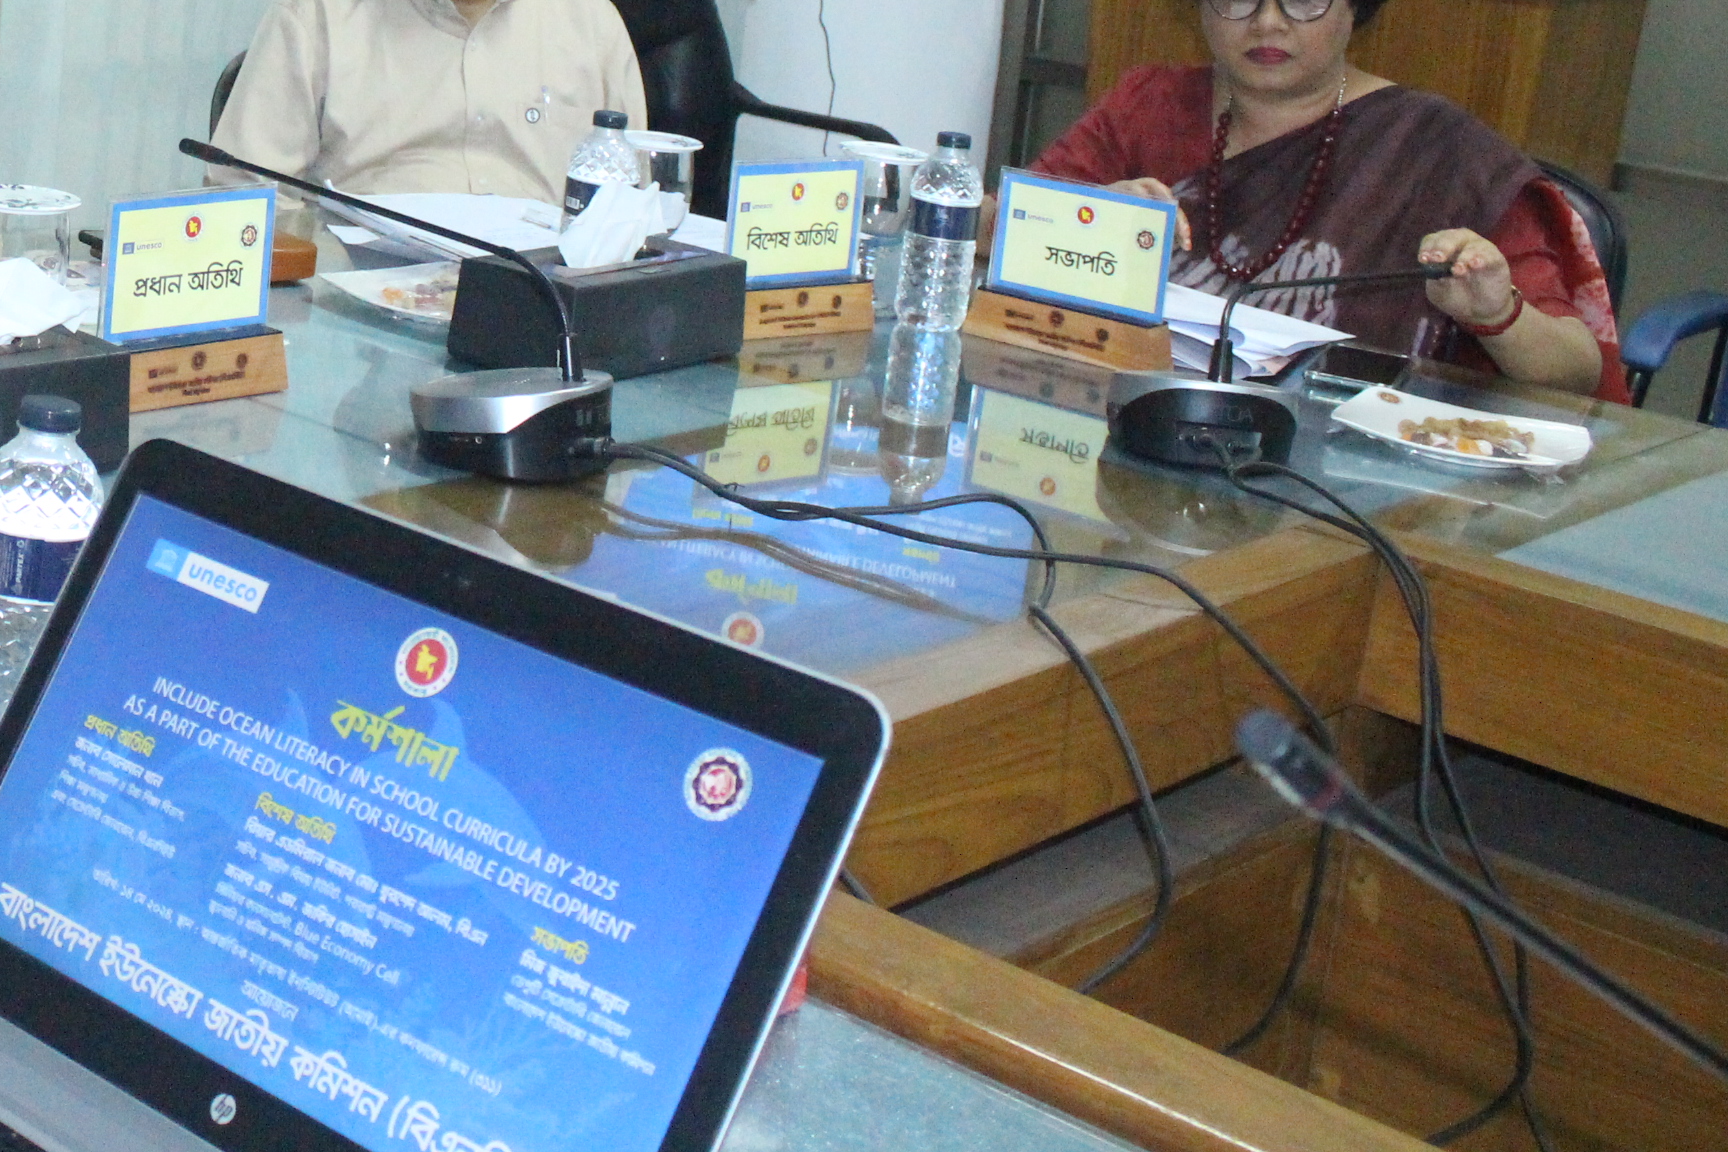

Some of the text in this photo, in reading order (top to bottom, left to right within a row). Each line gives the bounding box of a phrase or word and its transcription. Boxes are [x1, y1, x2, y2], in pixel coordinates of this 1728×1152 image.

[136, 241, 162, 251] unesco
[747, 221, 839, 250] বিশেষ অতিথি
[133, 259, 243, 298] প্রধান অতিথি
[1045, 245, 1118, 277] সভাপতি
[186, 562, 260, 604] unesco
[331, 702, 458, 780] কর্মশালা
[153, 677, 618, 900] INCLUDE OCEAN LITERACY IN SCHOOL CURRICULA BY 2025
[123, 695, 634, 940] AS A PART OF THE EDUCATION FOR SUSTAINABLE DEVELOPMENT
[294, 921, 400, 984] Blue Economy Cell
[531, 927, 588, 964] সভাপতি
[100, 936, 202, 1017] ইউনেস্কো
[204, 999, 287, 1066] জাতীয়
[290, 1046, 387, 1121] কমিশন
